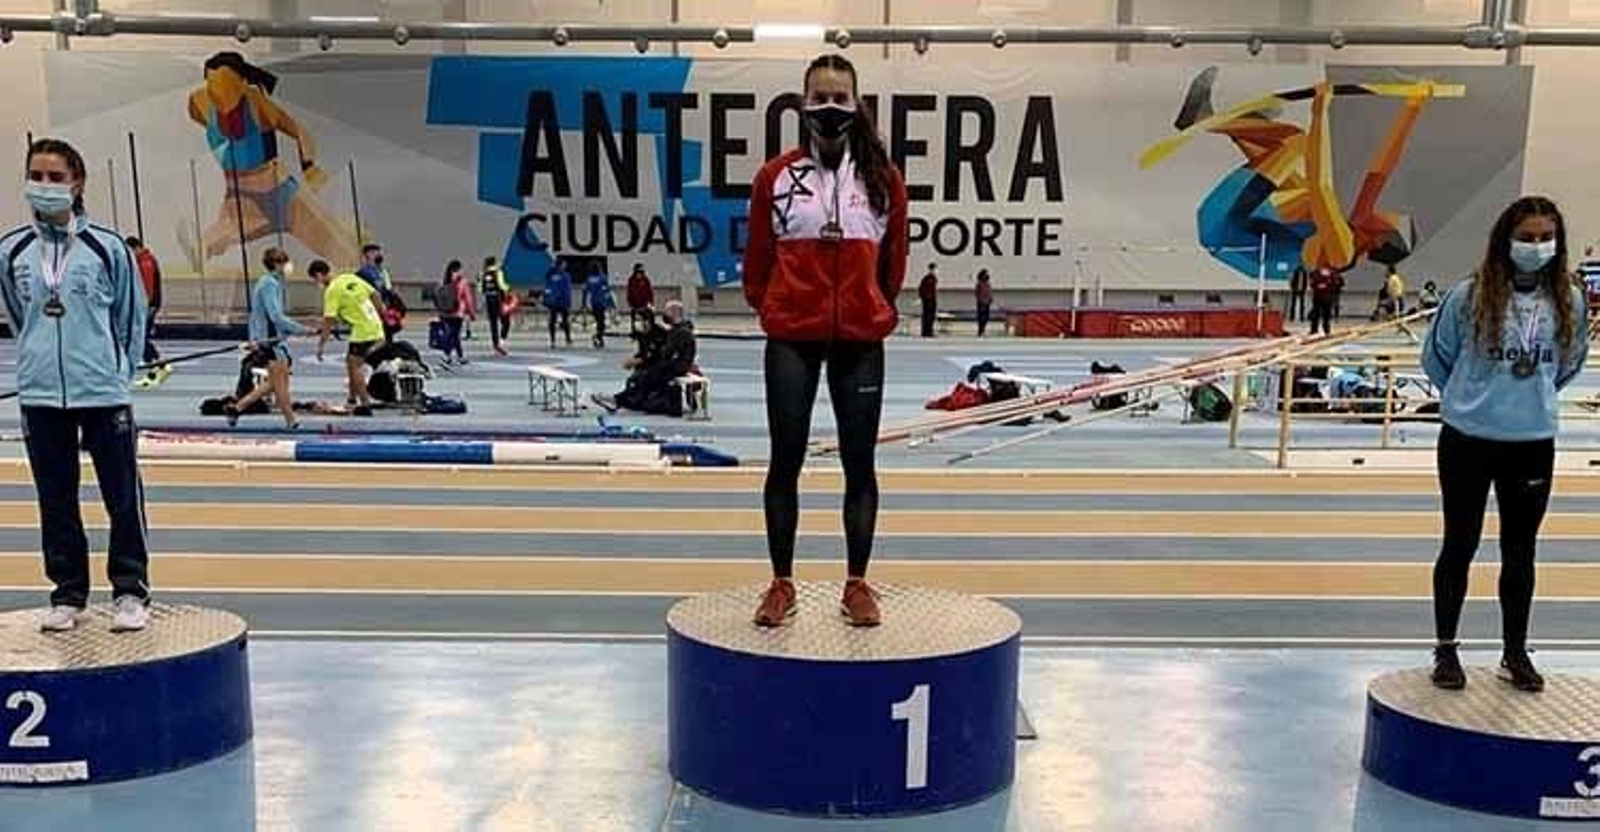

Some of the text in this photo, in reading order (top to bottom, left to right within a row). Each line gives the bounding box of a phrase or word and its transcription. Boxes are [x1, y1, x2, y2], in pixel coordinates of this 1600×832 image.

[516, 91, 1064, 202] ANTEERA
[515, 213, 714, 253] CIUDAD
[907, 217, 1063, 256] PORTE
[5, 690, 51, 748] 2
[891, 684, 930, 789] 1
[1574, 746, 1600, 798] 3
